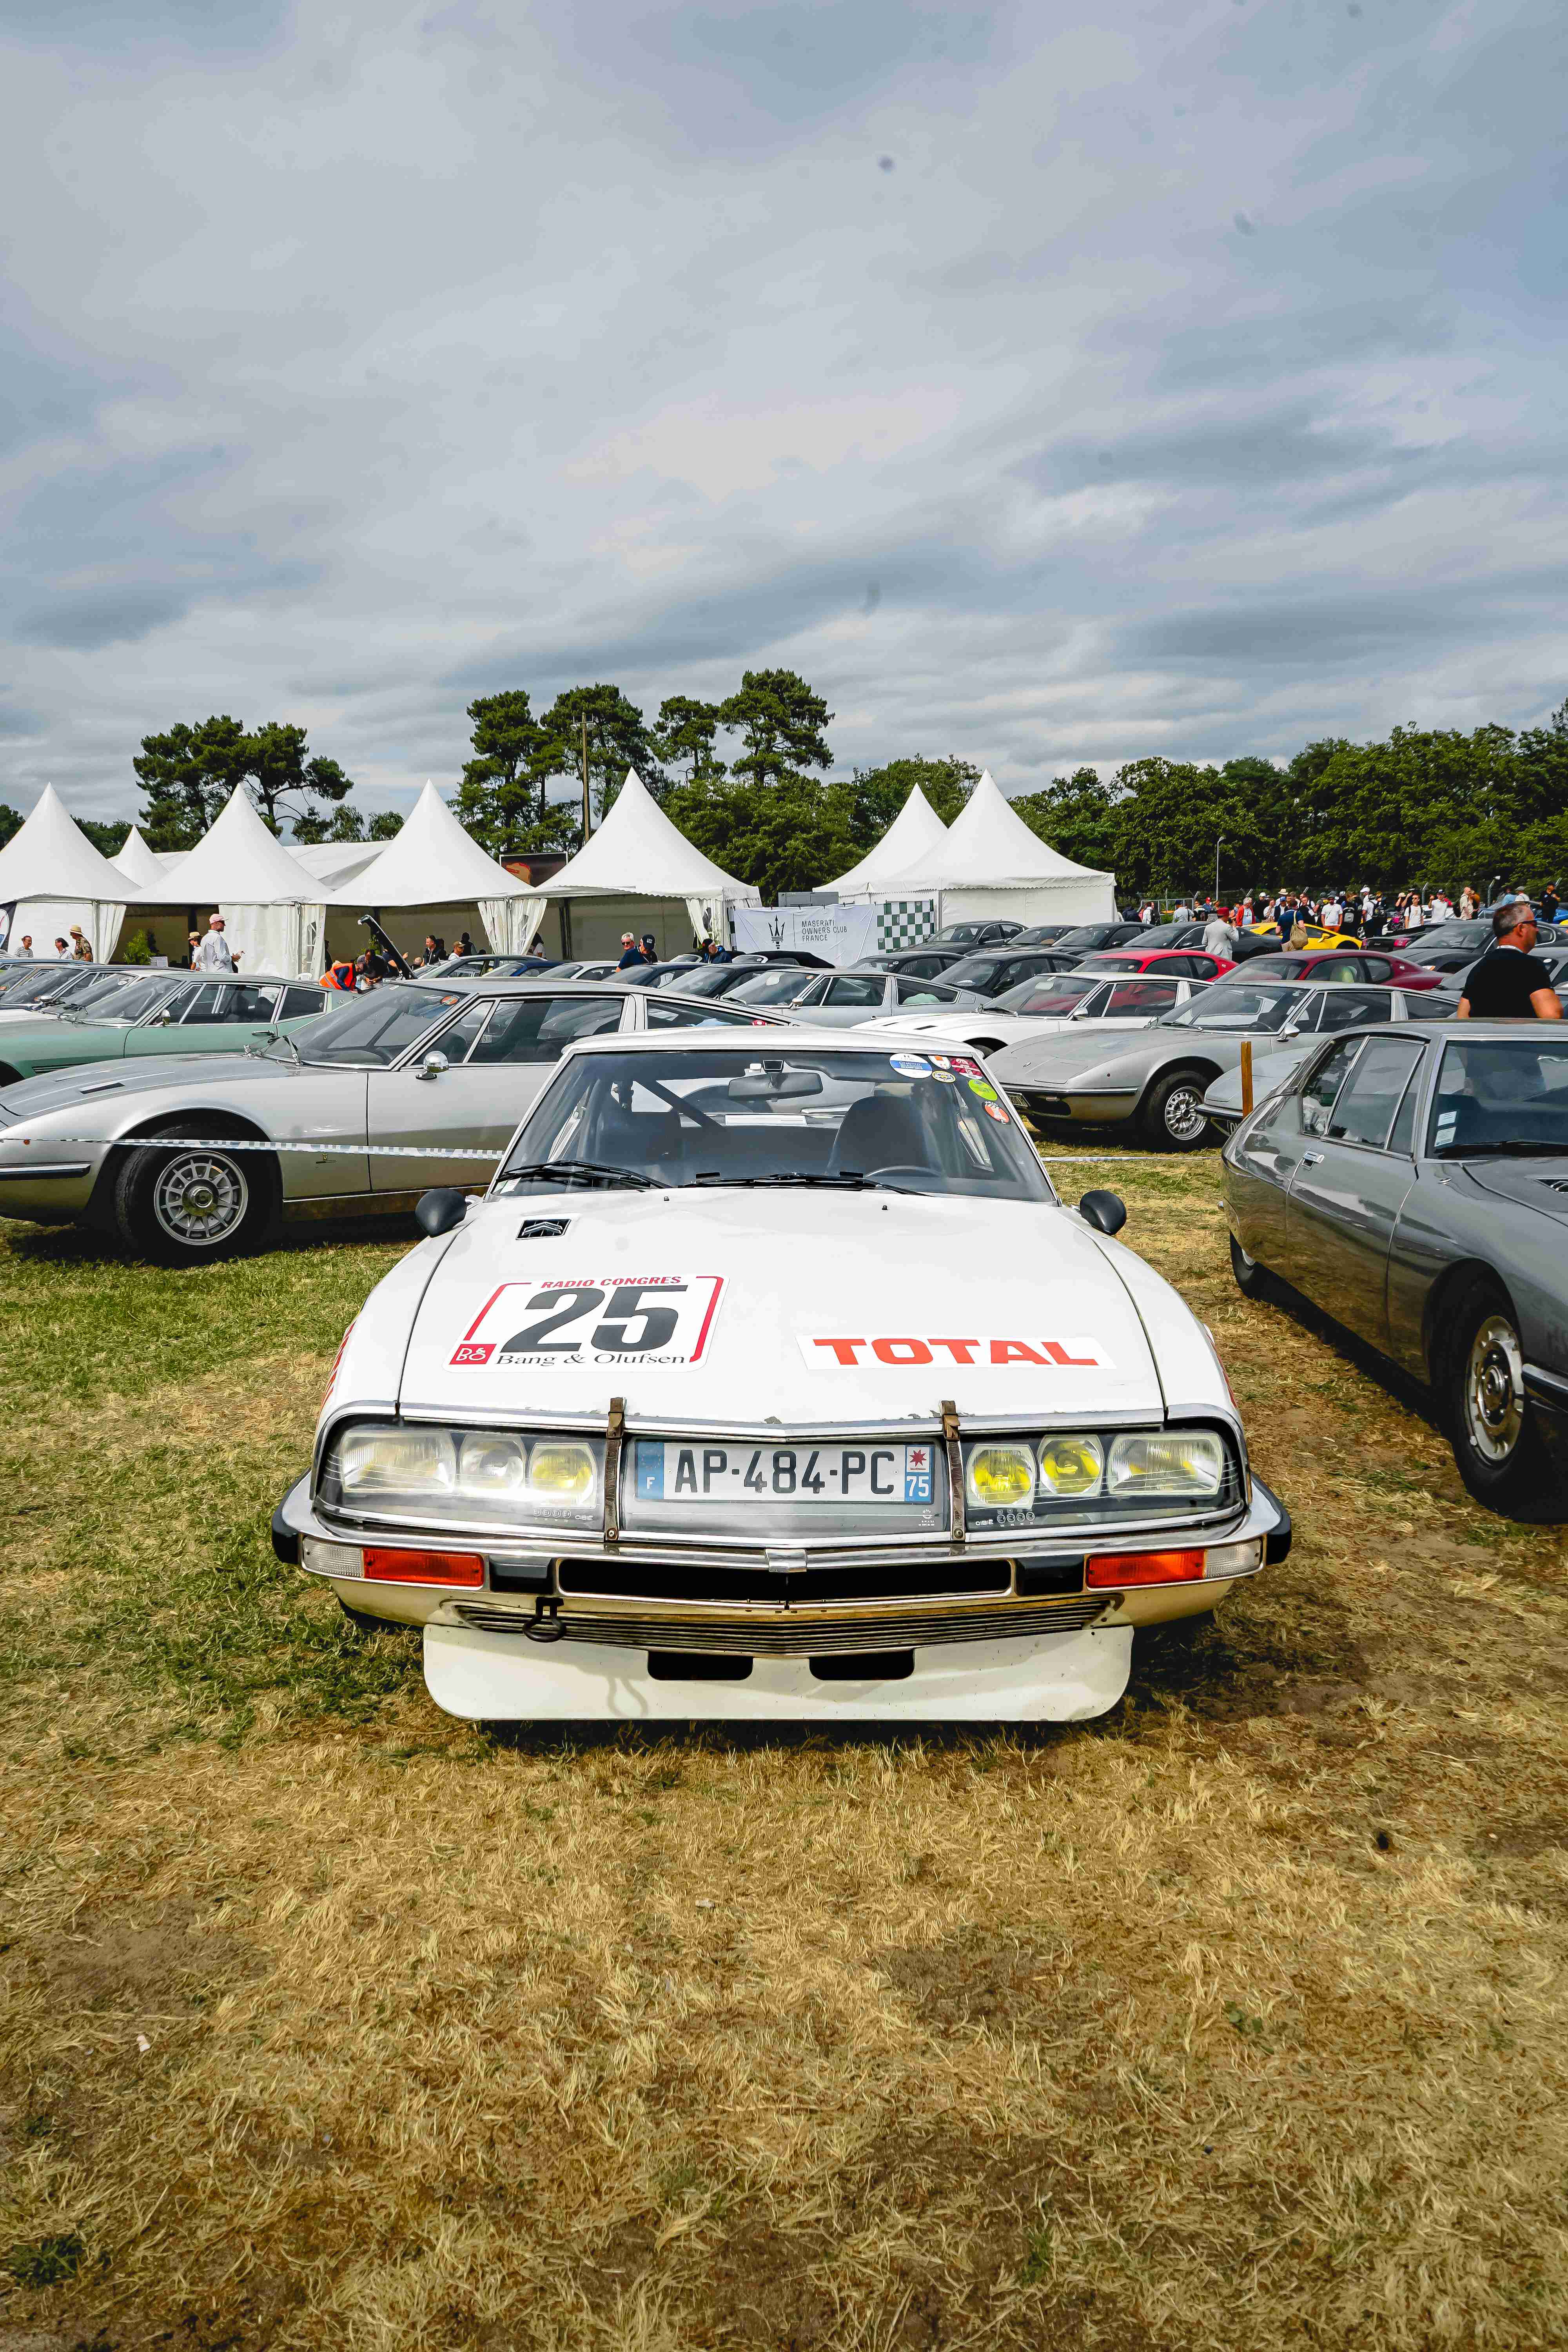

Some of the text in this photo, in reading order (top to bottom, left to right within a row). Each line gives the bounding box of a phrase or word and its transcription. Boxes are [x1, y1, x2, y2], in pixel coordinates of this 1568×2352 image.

[802, 919, 834, 927] MASERATI
[541, 1276, 681, 1289] RADIO CONGRES
[500, 1285, 688, 1353] 25
[495, 1353, 685, 1367] Bang & Olufsen
[813, 1338, 1099, 1366] TOTAL
[674, 1449, 895, 1495] AP-484-PC
[646, 1476, 655, 1490] F
[906, 1475, 929, 1497] 75
